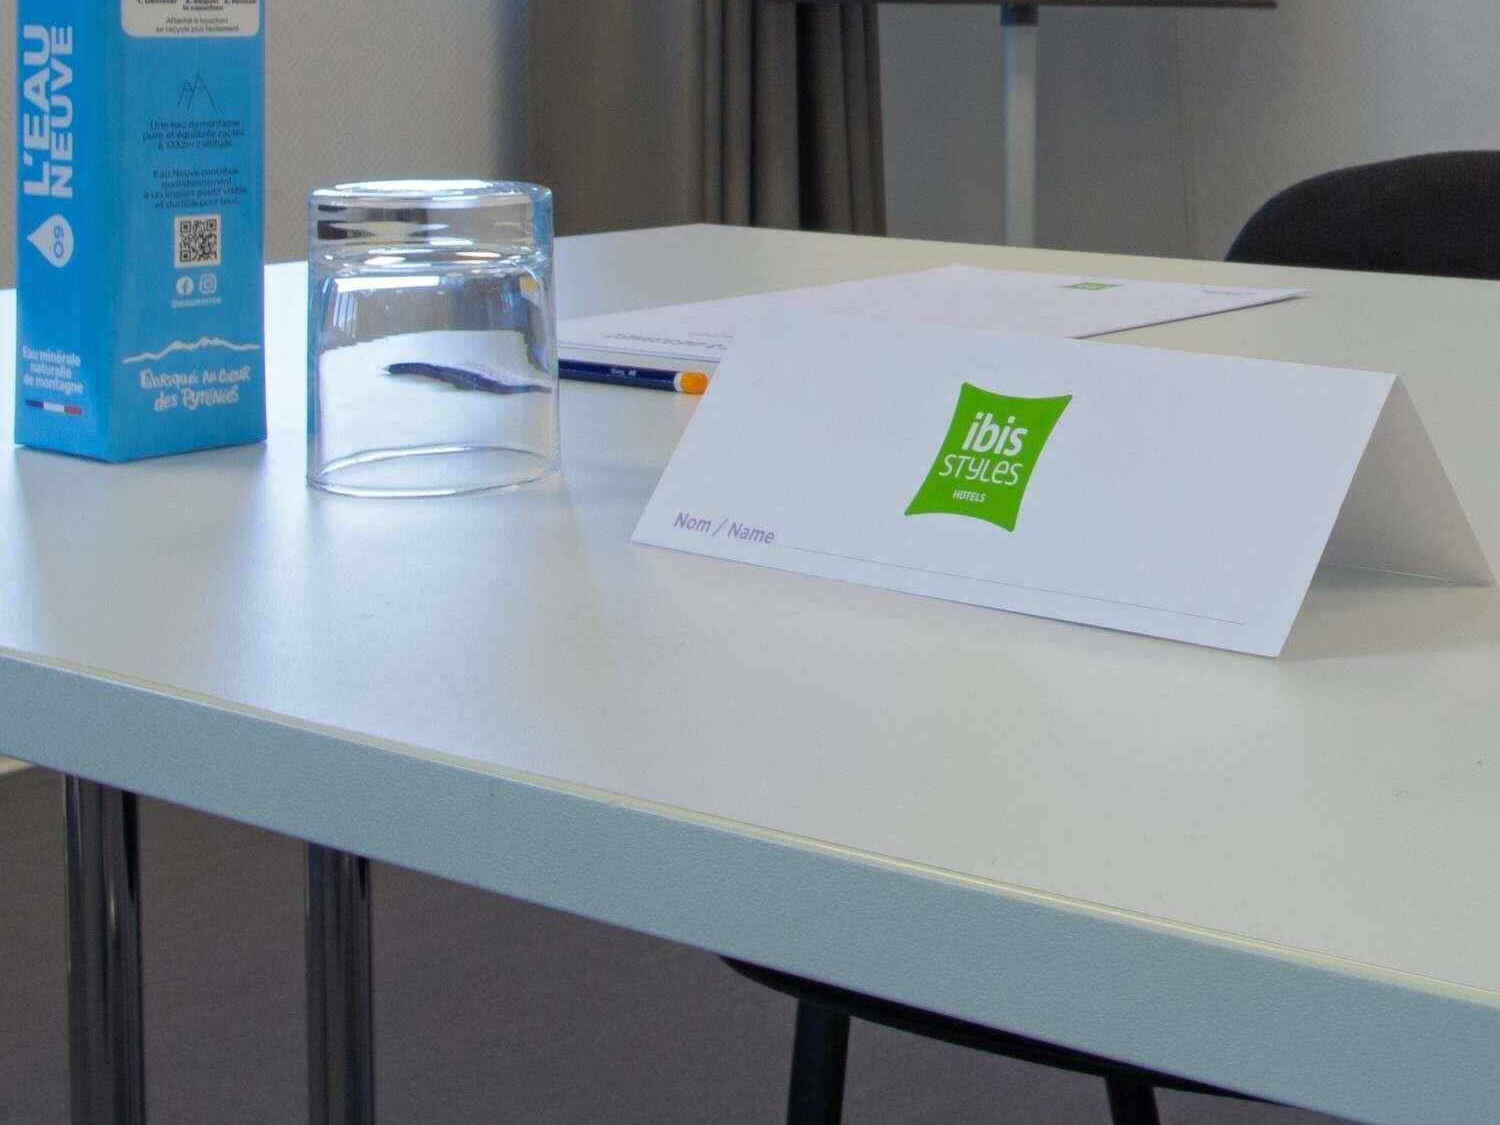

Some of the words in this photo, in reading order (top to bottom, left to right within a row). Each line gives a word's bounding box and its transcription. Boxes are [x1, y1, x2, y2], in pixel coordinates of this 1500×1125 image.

[23, 24, 50, 196] L'EAU
[50, 25, 74, 198] NEUVE
[22, 345, 39, 360] Eau
[39, 348, 81, 368] minérale
[35, 376, 84, 395] montagne
[962, 412, 1029, 457] ibis
[952, 488, 987, 503] HOTELS
[672, 512, 712, 534] Nom
[727, 521, 776, 545] Name
